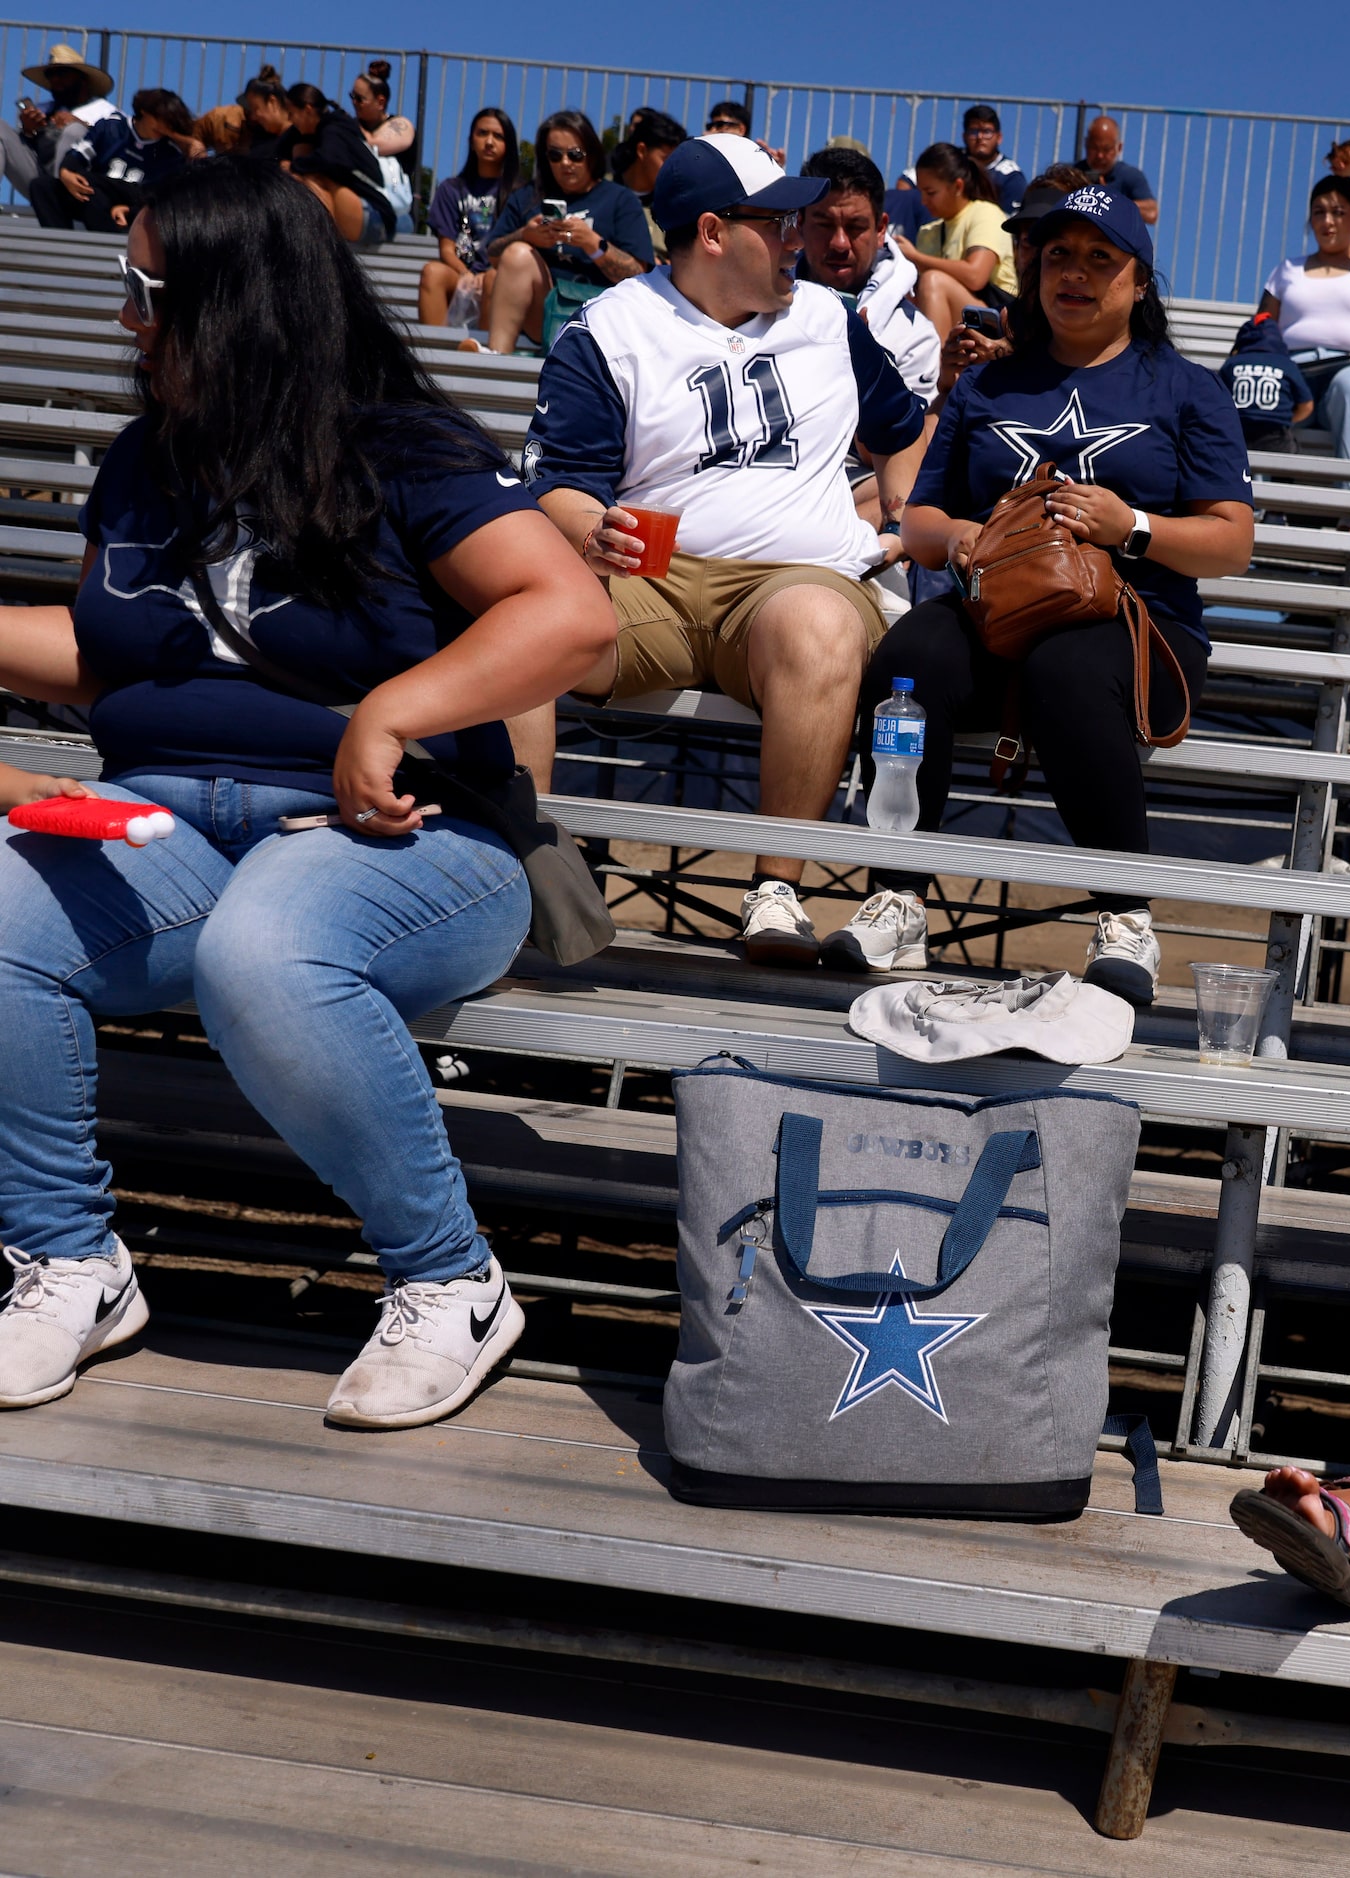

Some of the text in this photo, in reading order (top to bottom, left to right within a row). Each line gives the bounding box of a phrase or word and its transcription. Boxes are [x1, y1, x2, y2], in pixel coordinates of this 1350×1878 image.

[1067, 186, 1113, 205] DALLAS
[730, 342, 745, 353] NFL
[1233, 365, 1284, 379] CASAS
[1233, 376, 1282, 411] 00
[685, 353, 799, 475] 11
[878, 719, 896, 732] DEJA
[877, 733, 896, 746] BLUE
[847, 1133, 970, 1166] COWBOYS
